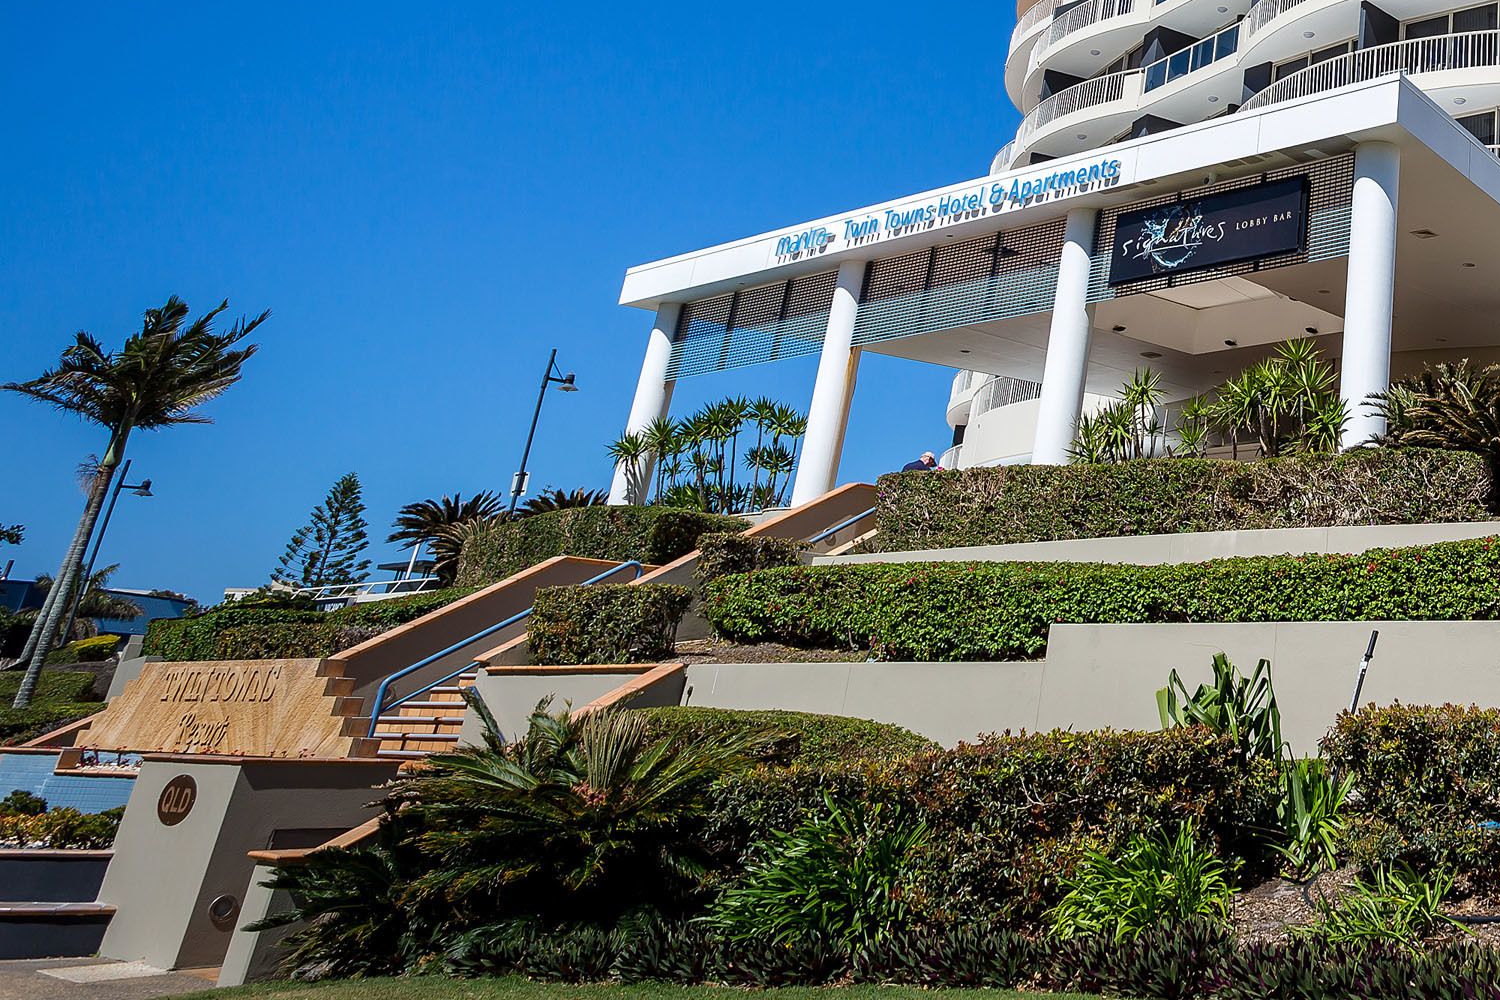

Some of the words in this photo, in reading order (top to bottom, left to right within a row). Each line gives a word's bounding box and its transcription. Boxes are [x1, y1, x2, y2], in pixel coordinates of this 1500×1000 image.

[775, 226, 835, 257] mantra
[843, 214, 879, 241] Twin
[884, 204, 934, 231] Towns
[938, 186, 985, 218] Hotel
[988, 182, 1005, 205] &
[1007, 157, 1119, 208] Apartments
[1235, 215, 1269, 231] LOBBY
[1272, 210, 1293, 223] BAR
[161, 785, 192, 814] QLD
